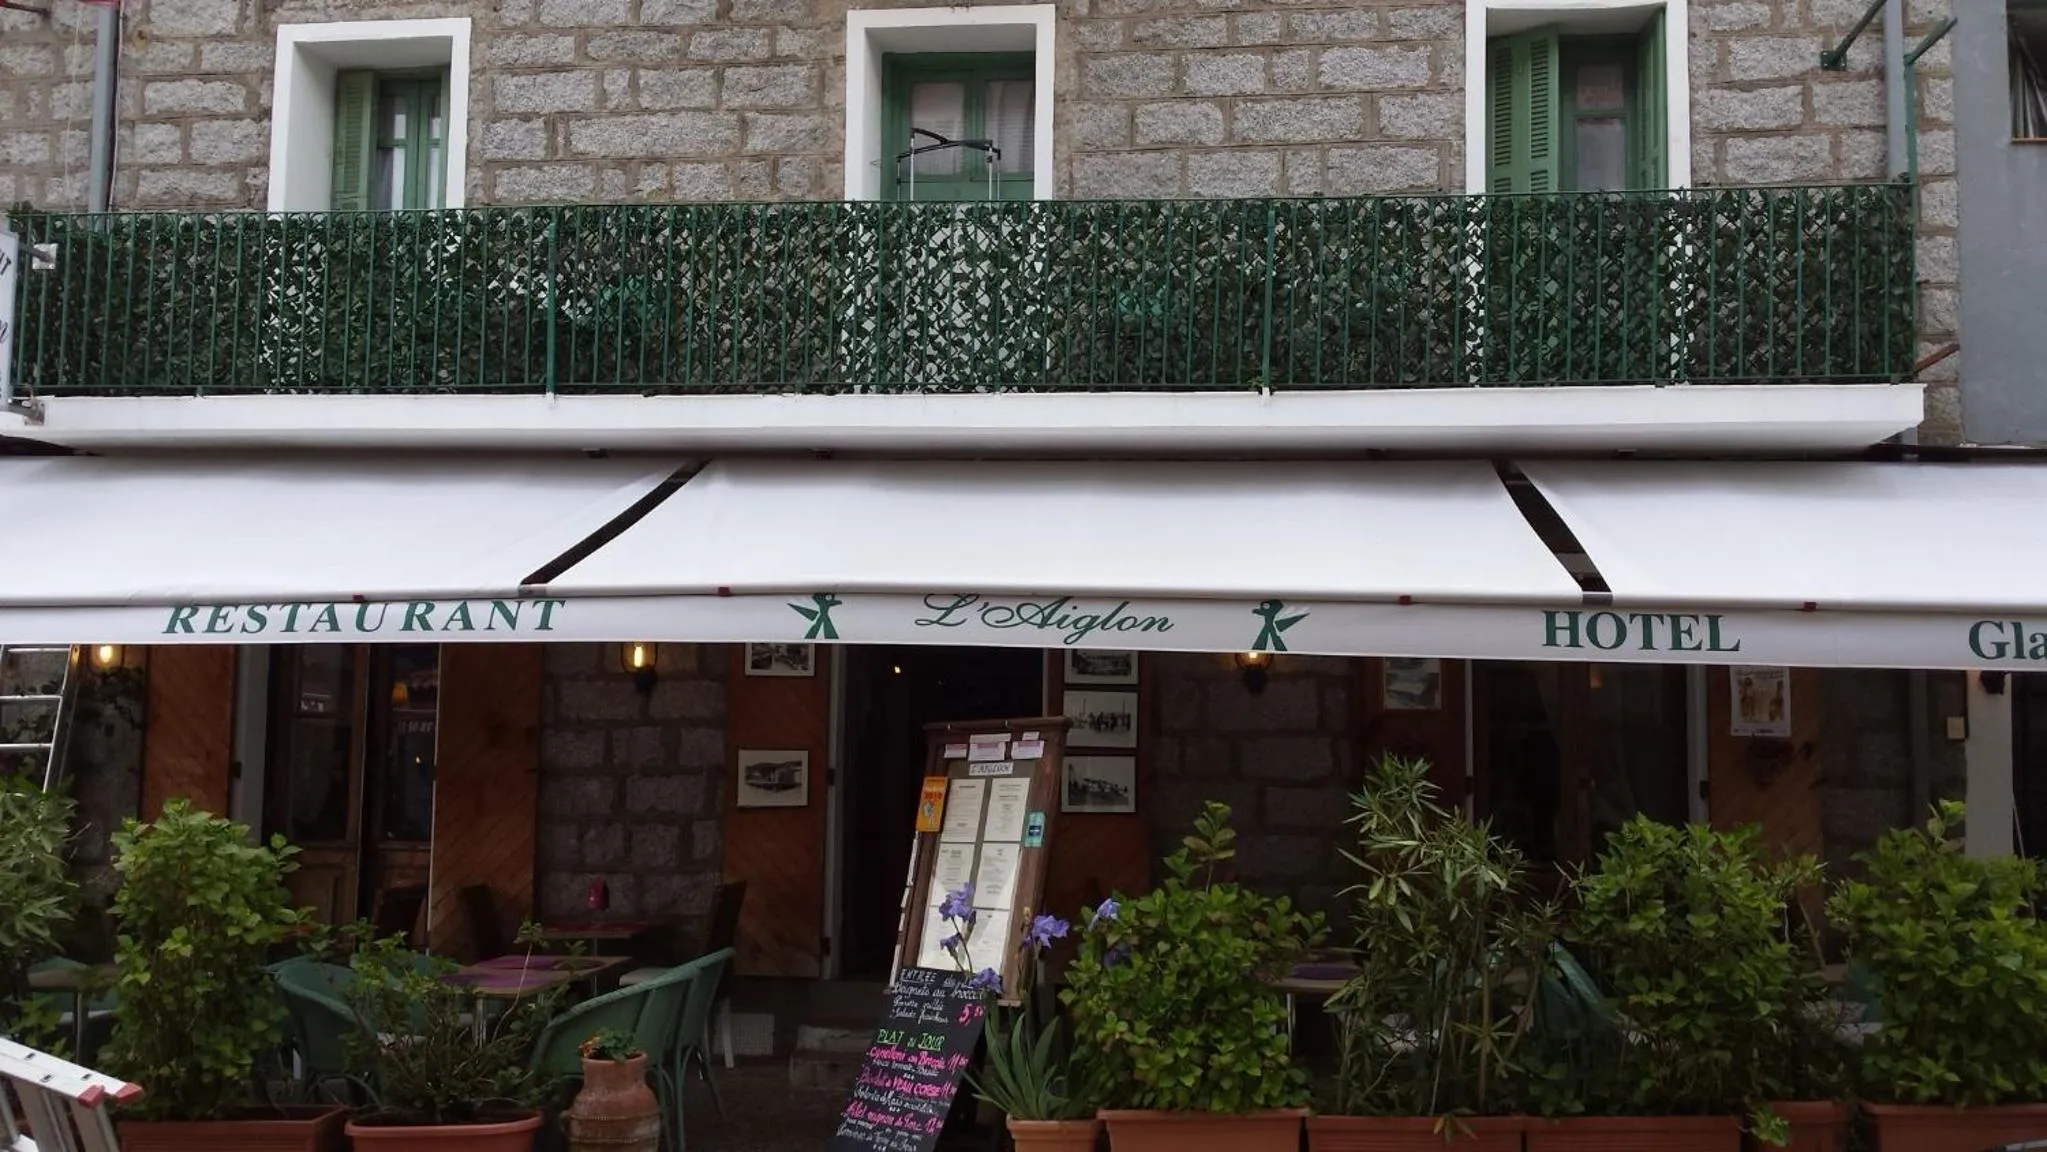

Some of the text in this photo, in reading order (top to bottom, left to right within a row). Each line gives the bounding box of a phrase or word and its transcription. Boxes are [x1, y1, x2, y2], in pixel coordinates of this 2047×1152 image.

[161, 600, 566, 634] RESTAURANT
[914, 593, 1175, 645] L'Aiglon
[1541, 611, 1741, 652] HOTEL
[877, 1028, 904, 1044] PLAT
[918, 1032, 945, 1050] JOUR
